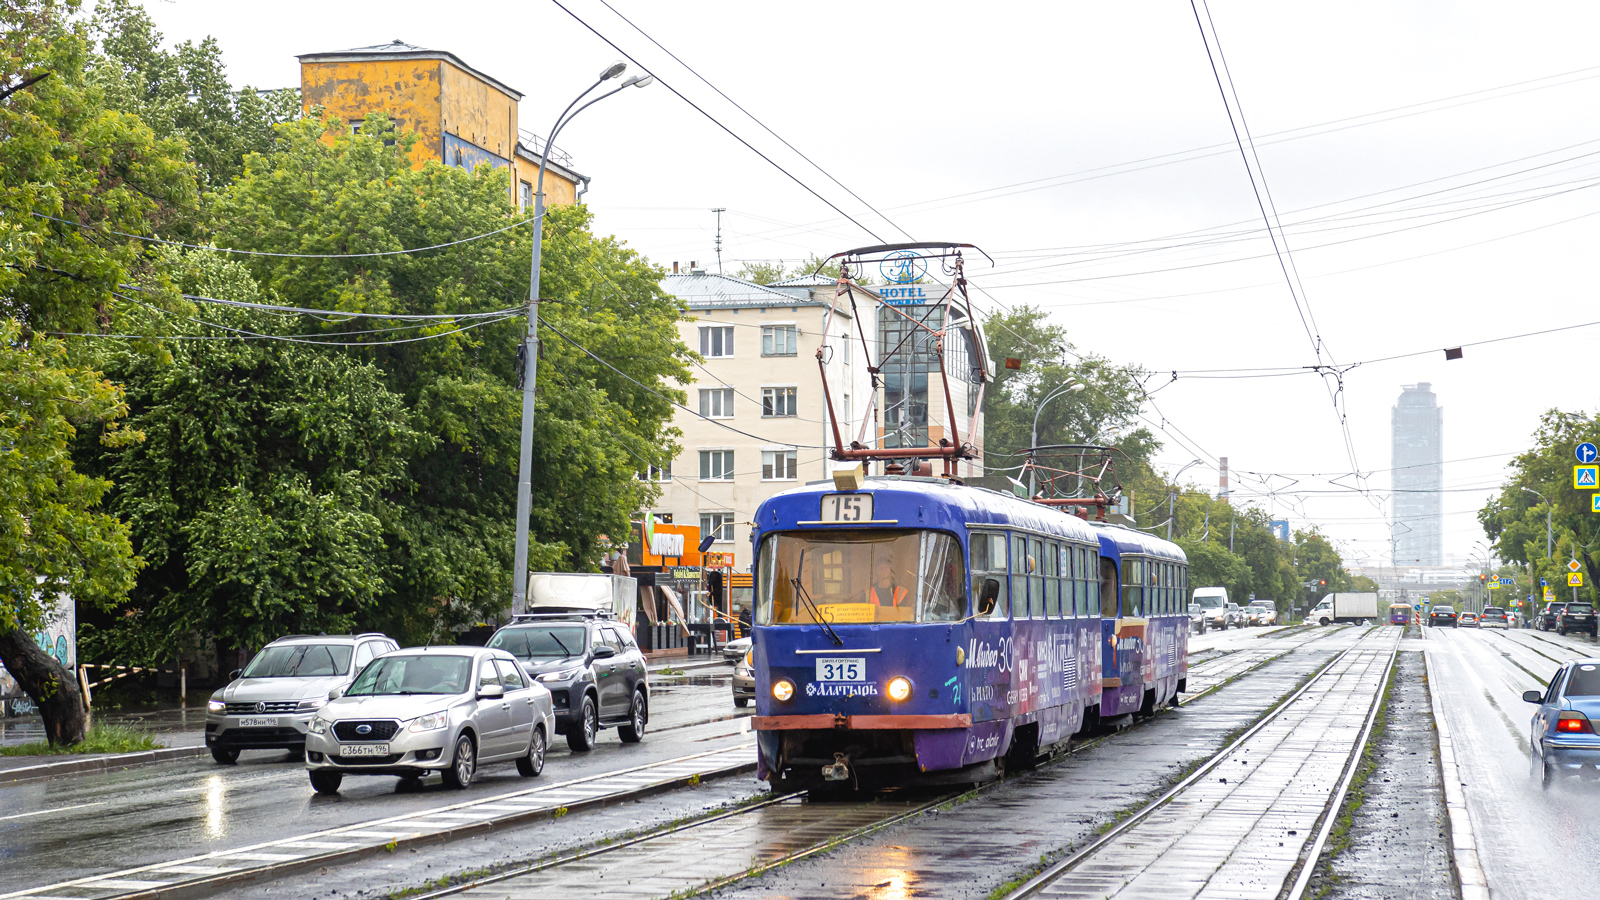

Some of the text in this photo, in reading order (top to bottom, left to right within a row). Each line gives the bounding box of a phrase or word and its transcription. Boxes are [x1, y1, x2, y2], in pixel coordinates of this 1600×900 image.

[880, 287, 926, 298] HOTEL
[831, 497, 861, 521] 15
[818, 606, 835, 623] 15
[998, 636, 1014, 673] 30
[824, 664, 858, 680] 315
[817, 682, 878, 697] Алатырь
[374, 745, 387, 753] 196
